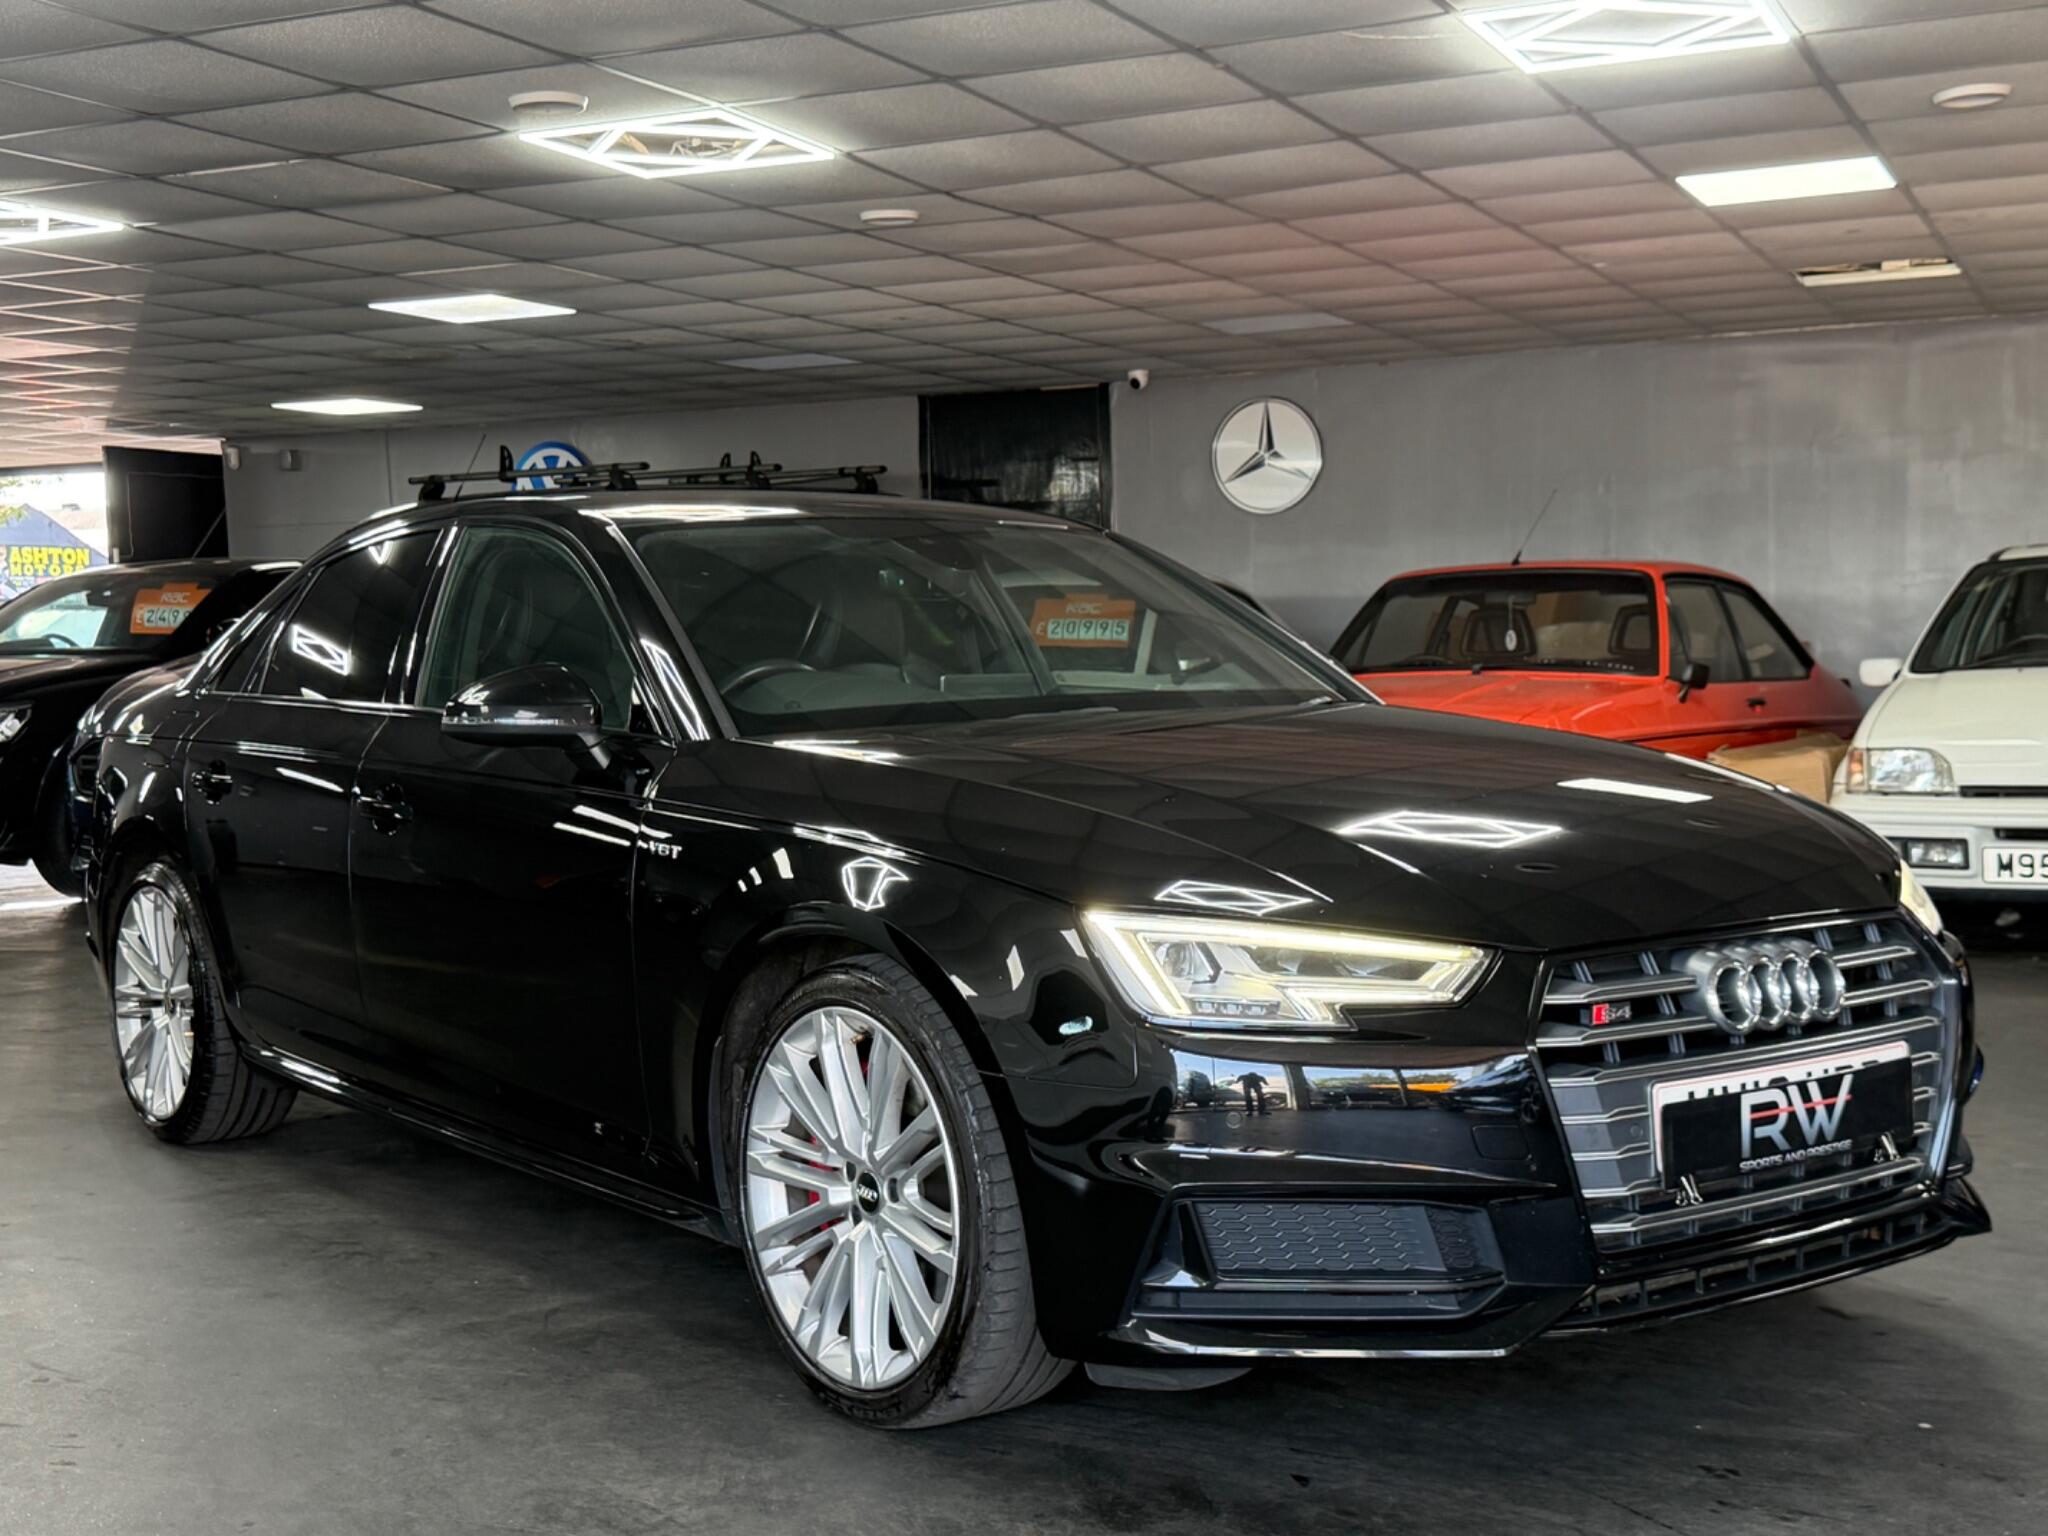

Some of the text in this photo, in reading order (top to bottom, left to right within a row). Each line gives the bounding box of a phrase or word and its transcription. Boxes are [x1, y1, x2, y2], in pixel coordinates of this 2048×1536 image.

[10, 545, 90, 565] ASHTON
[1741, 1073, 1854, 1159] RW
[1739, 1138, 1853, 1173] SPORTS AND PRESTIGE
